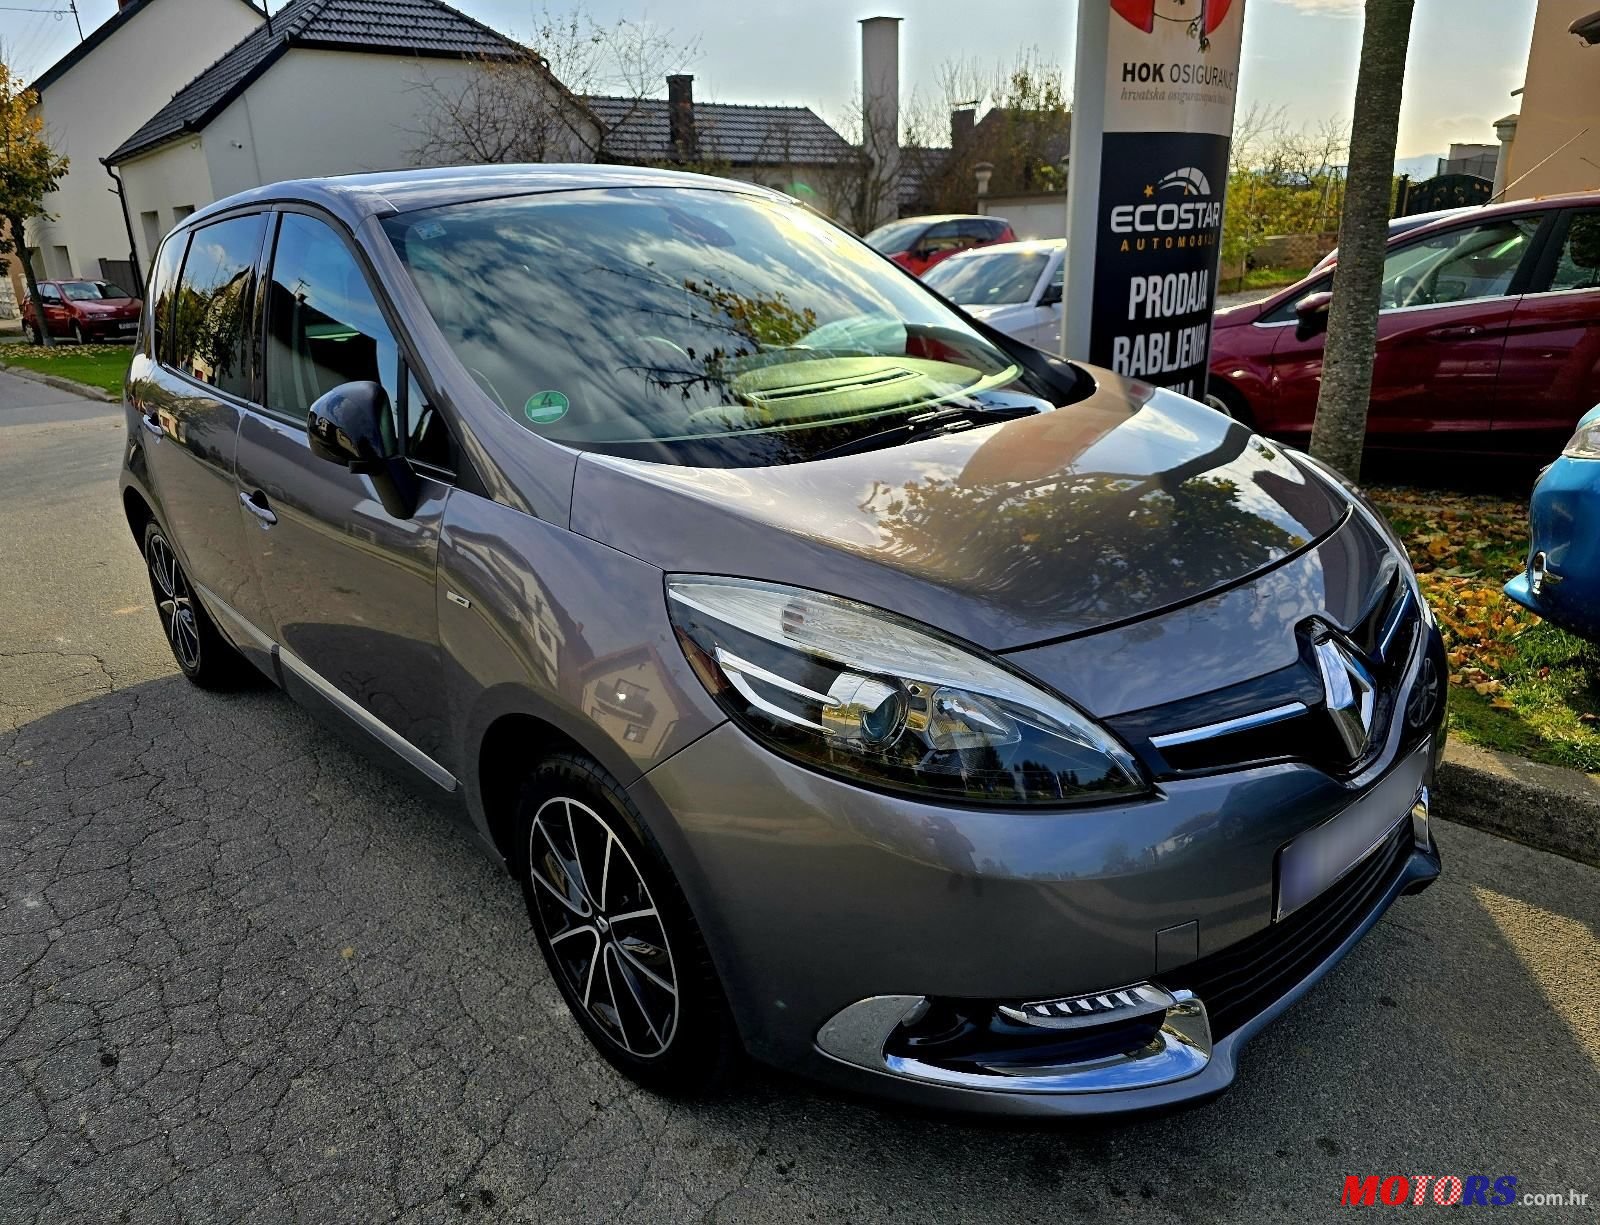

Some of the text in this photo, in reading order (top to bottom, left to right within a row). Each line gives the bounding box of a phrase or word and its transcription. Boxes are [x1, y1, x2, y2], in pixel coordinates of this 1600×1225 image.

[1122, 62, 1165, 83] HOK
[1120, 87, 1165, 101] hrvatska
[1110, 202, 1221, 233] ECOSTAR
[1128, 269, 1208, 320] PRODAJA
[1112, 322, 1207, 377] RABLJENIH
[541, 392, 552, 407] 4
